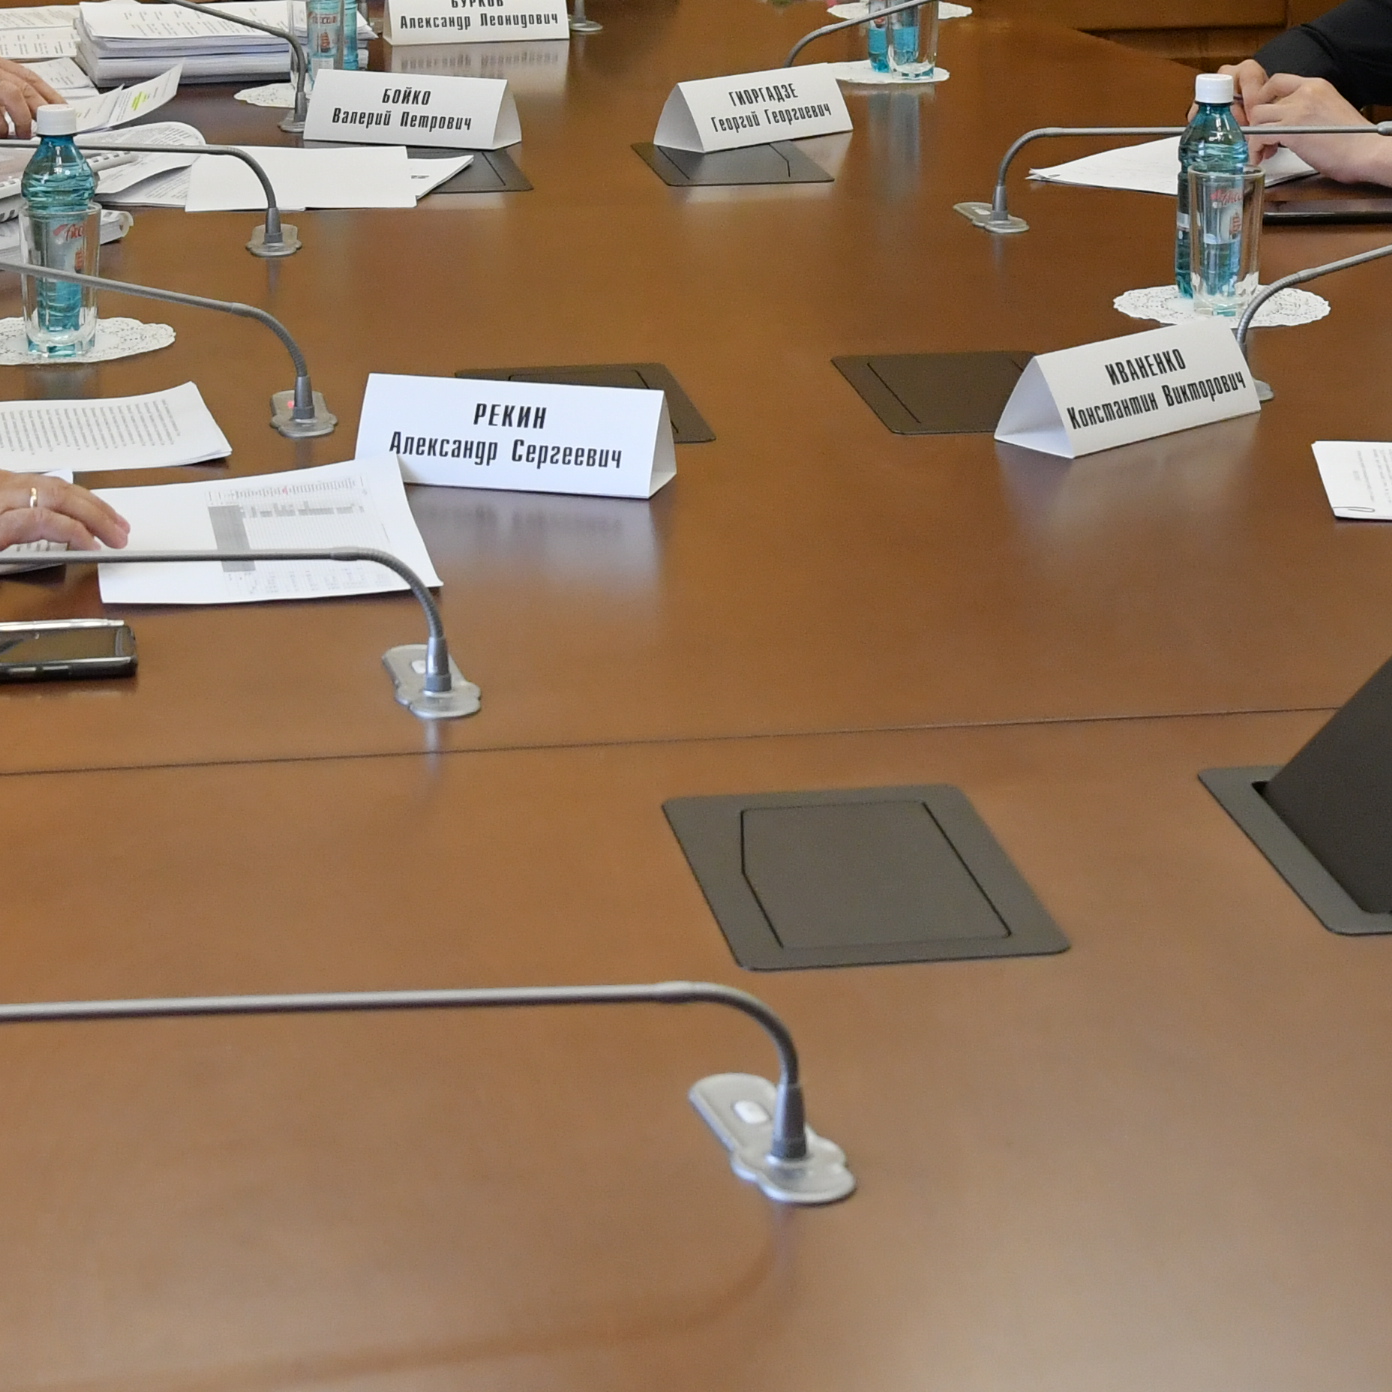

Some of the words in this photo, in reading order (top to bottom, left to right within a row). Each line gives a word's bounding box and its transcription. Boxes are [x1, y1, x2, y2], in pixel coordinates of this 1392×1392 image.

[400, 15, 471, 30] Александр
[480, 13, 558, 28] Леонидович
[382, 87, 431, 105] БОЙКО
[728, 83, 798, 107] ГИОРГАДЗЕ
[332, 108, 391, 129] Валерий
[400, 111, 472, 132] Петрович
[710, 111, 760, 133] Георгий
[764, 103, 832, 125] Георгиевич
[1105, 348, 1186, 386] ИВАНЕНКО
[1066, 392, 1159, 430] Константин
[1161, 371, 1246, 407] Викторович
[473, 403, 547, 429] РЕКИН
[389, 431, 498, 466] Александр
[511, 439, 622, 469] Сергеевич
